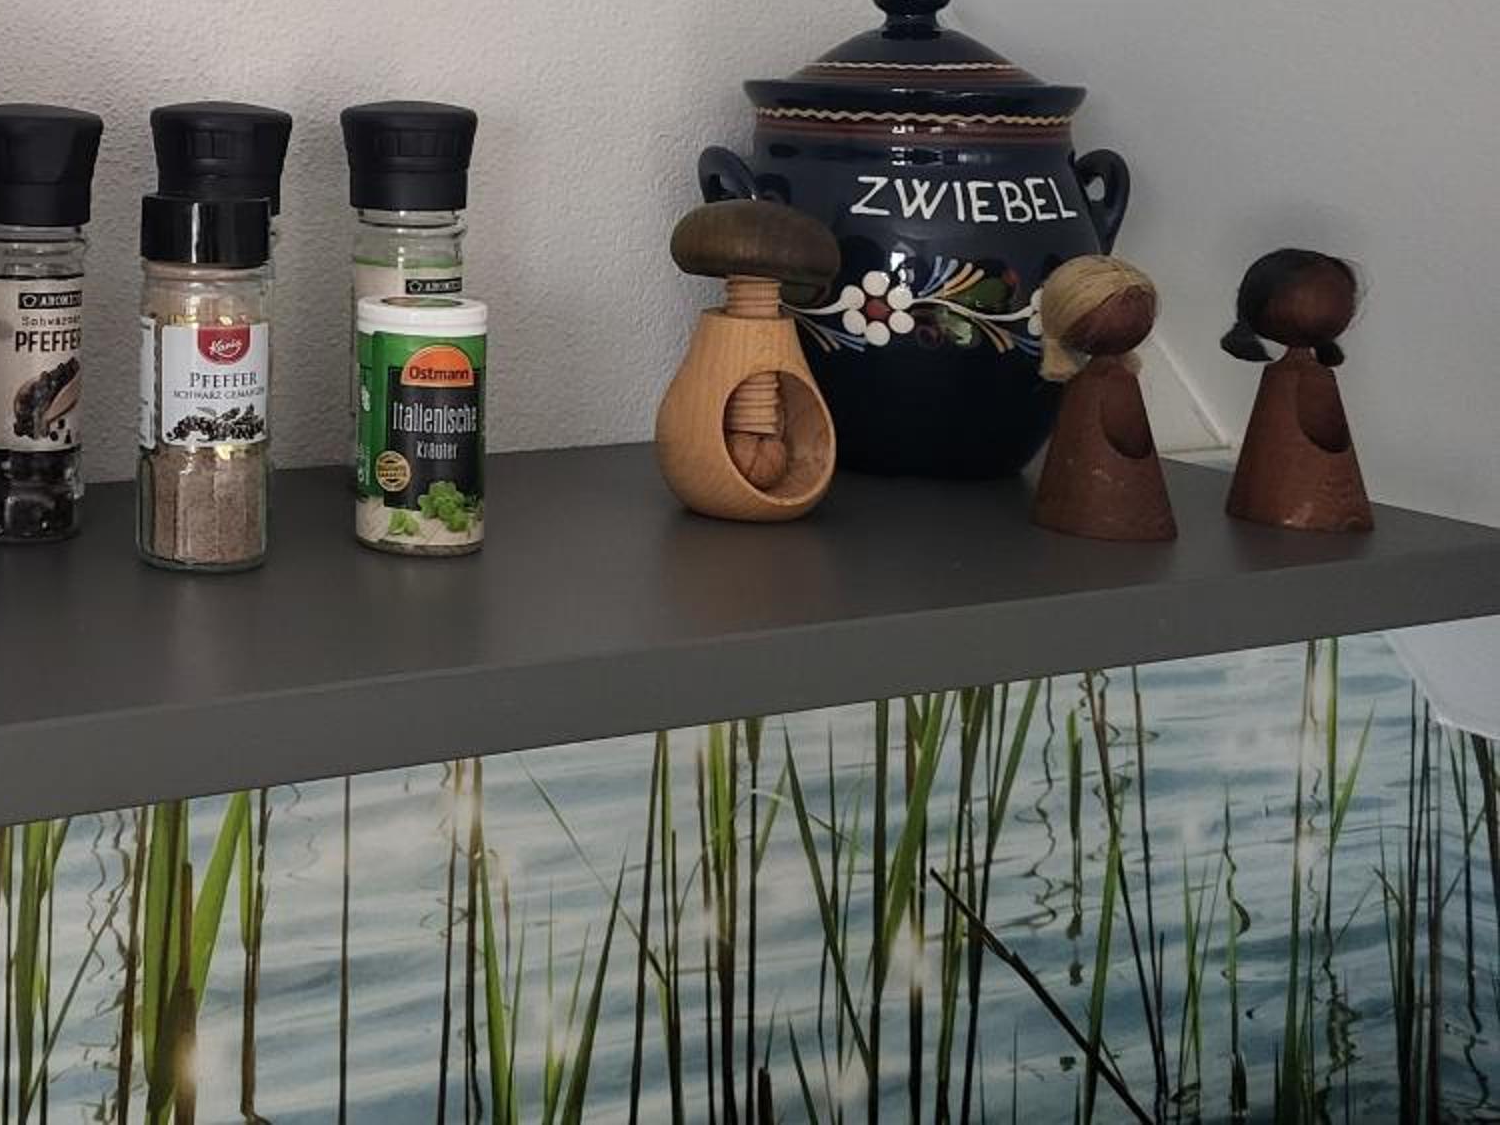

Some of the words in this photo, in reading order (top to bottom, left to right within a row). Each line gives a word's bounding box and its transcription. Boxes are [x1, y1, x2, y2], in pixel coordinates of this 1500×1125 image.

[850, 176, 1078, 222] ZWIEBEL
[190, 372, 258, 388] PFEFFER
[409, 366, 470, 381] Ostmann
[416, 440, 458, 460] Kräuter
